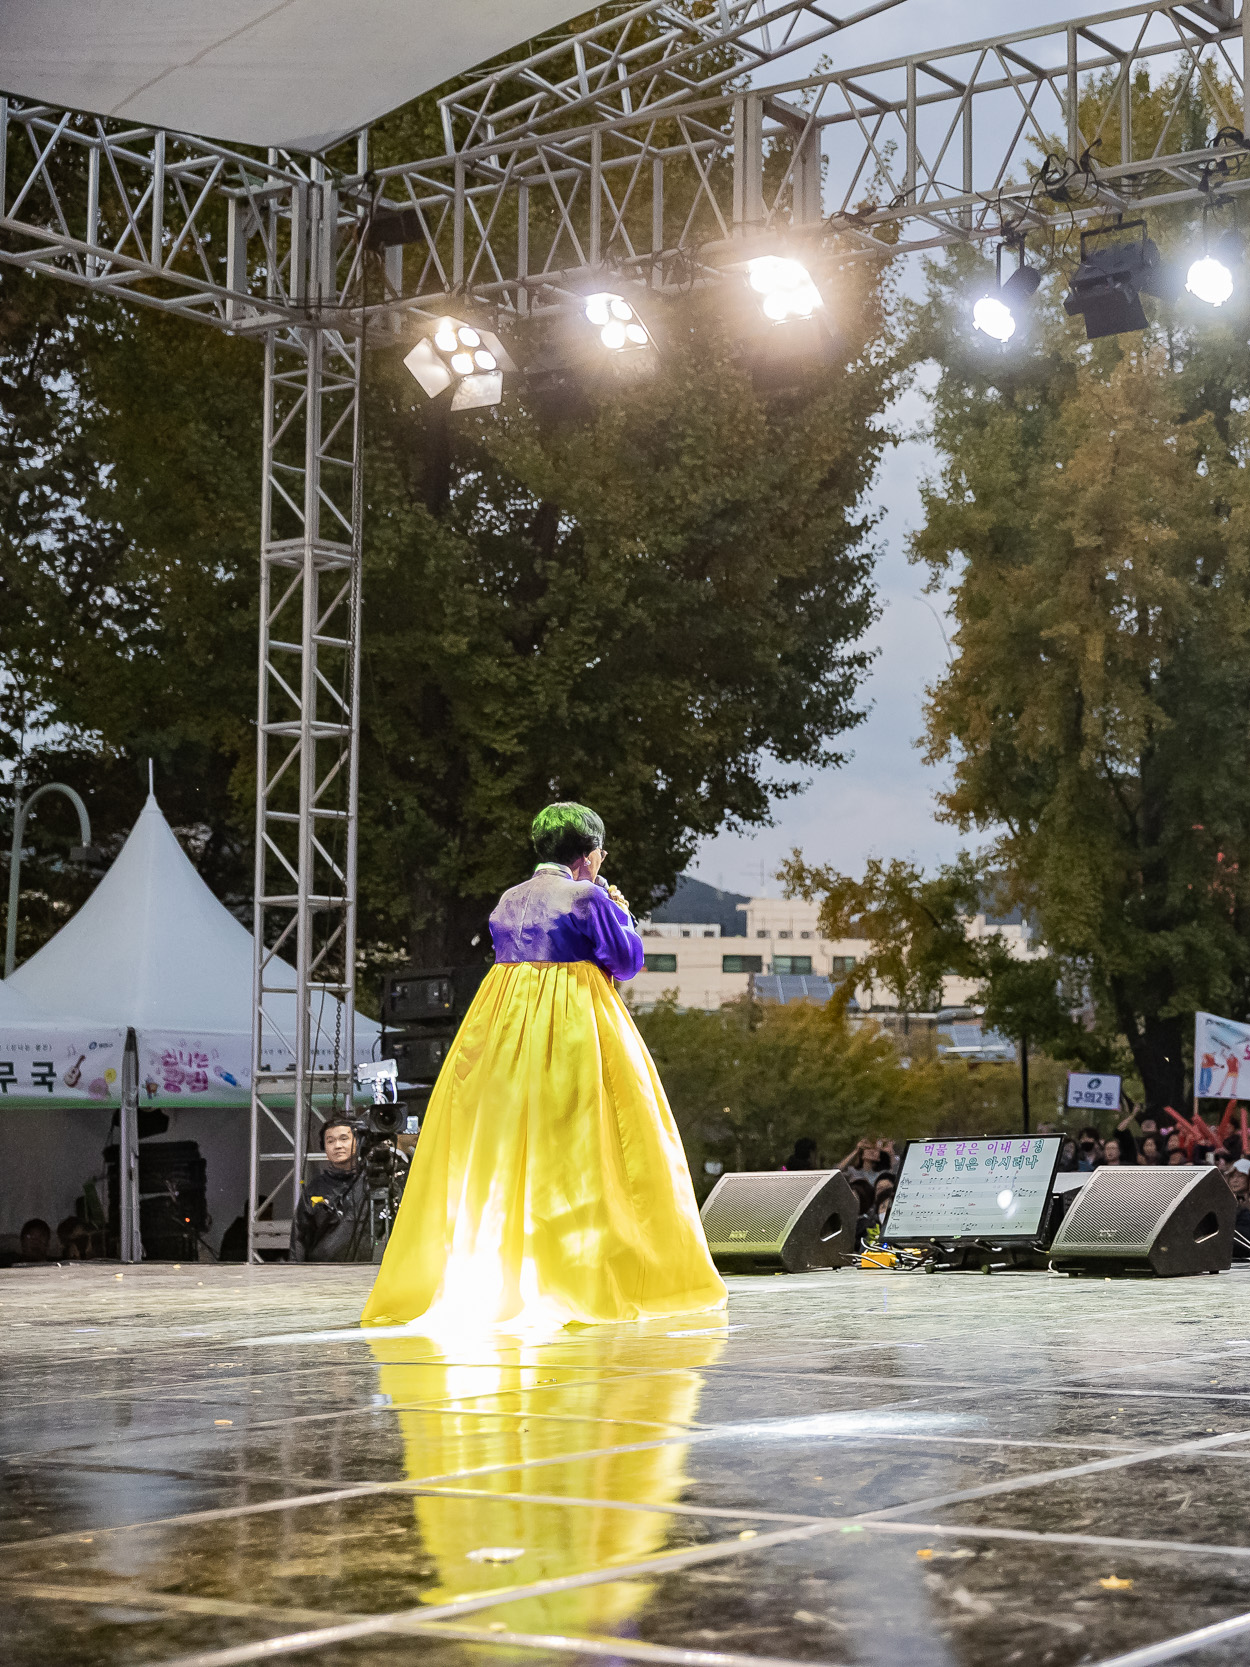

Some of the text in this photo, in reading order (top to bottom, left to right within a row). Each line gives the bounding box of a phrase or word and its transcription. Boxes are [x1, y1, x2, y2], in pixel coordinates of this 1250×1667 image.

[1073, 1090, 1113, 1106] 구의2동
[924, 1138, 1045, 1156] 먹물 같은 이내 심정
[920, 1154, 1039, 1173] 사랑 님은 아시려나
